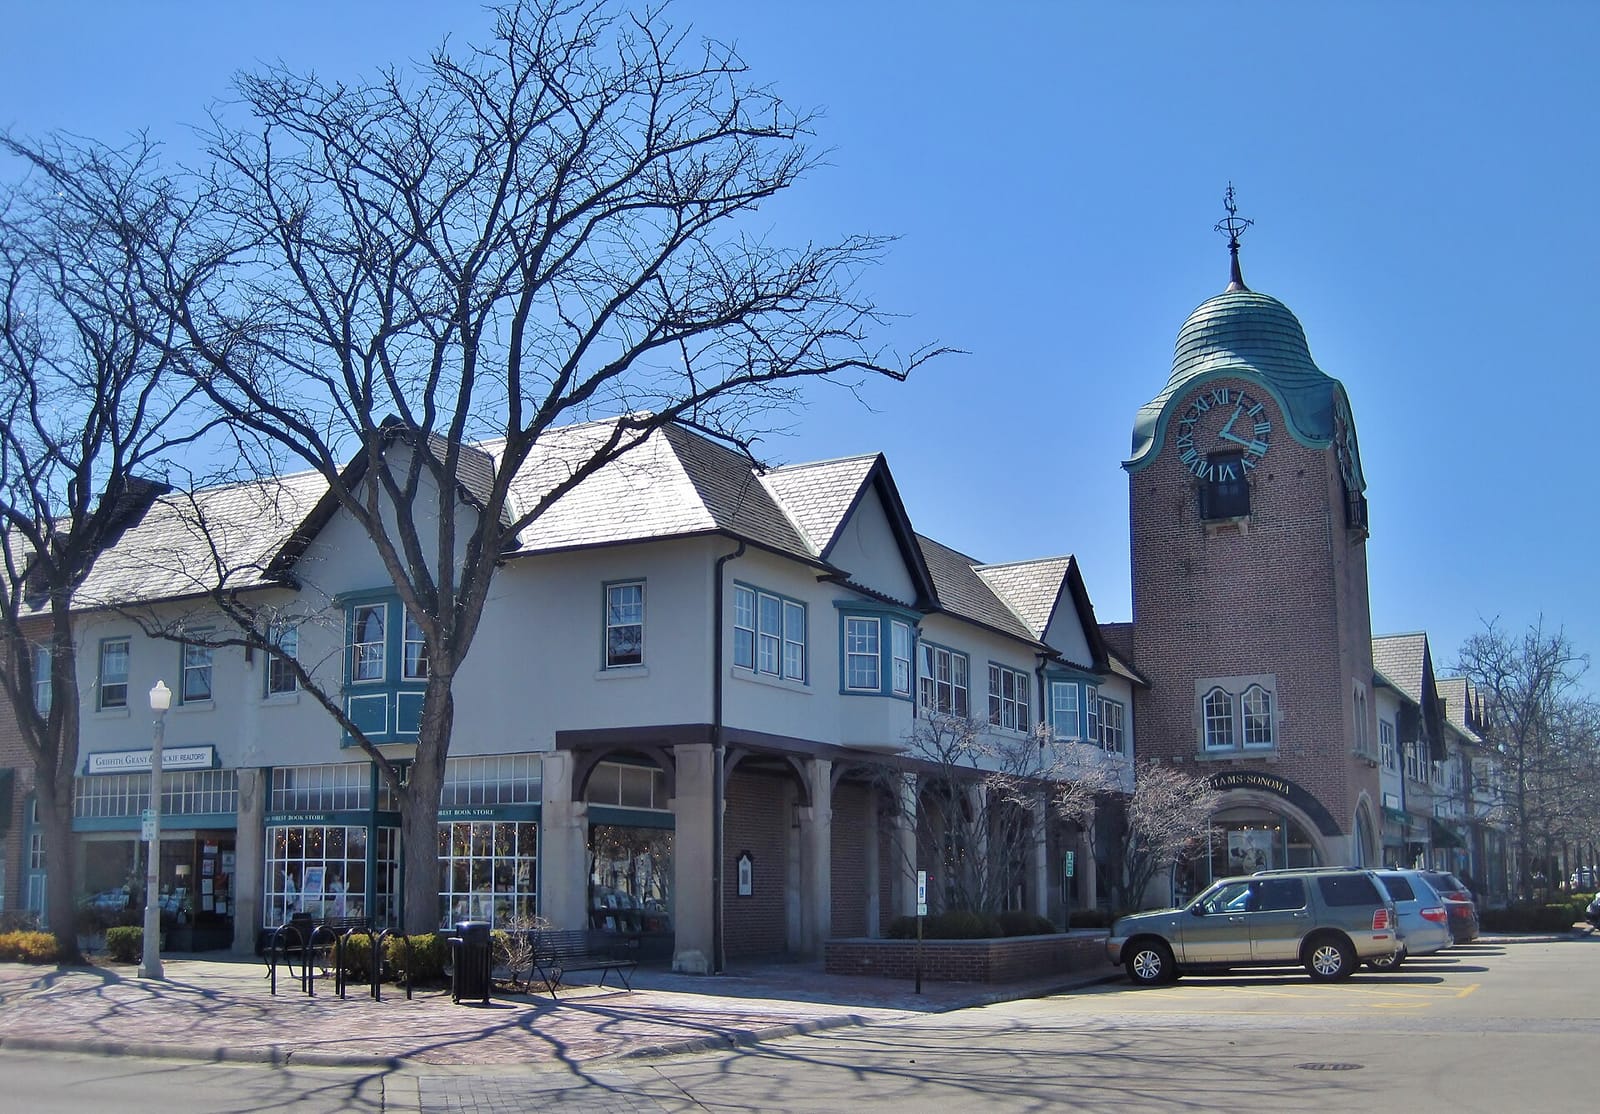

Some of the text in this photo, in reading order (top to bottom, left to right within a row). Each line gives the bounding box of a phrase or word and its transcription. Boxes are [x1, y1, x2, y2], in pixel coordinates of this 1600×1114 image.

[1211, 388, 1229, 406] XII
[1247, 402, 1264, 417] II
[1253, 421, 1271, 434] III
